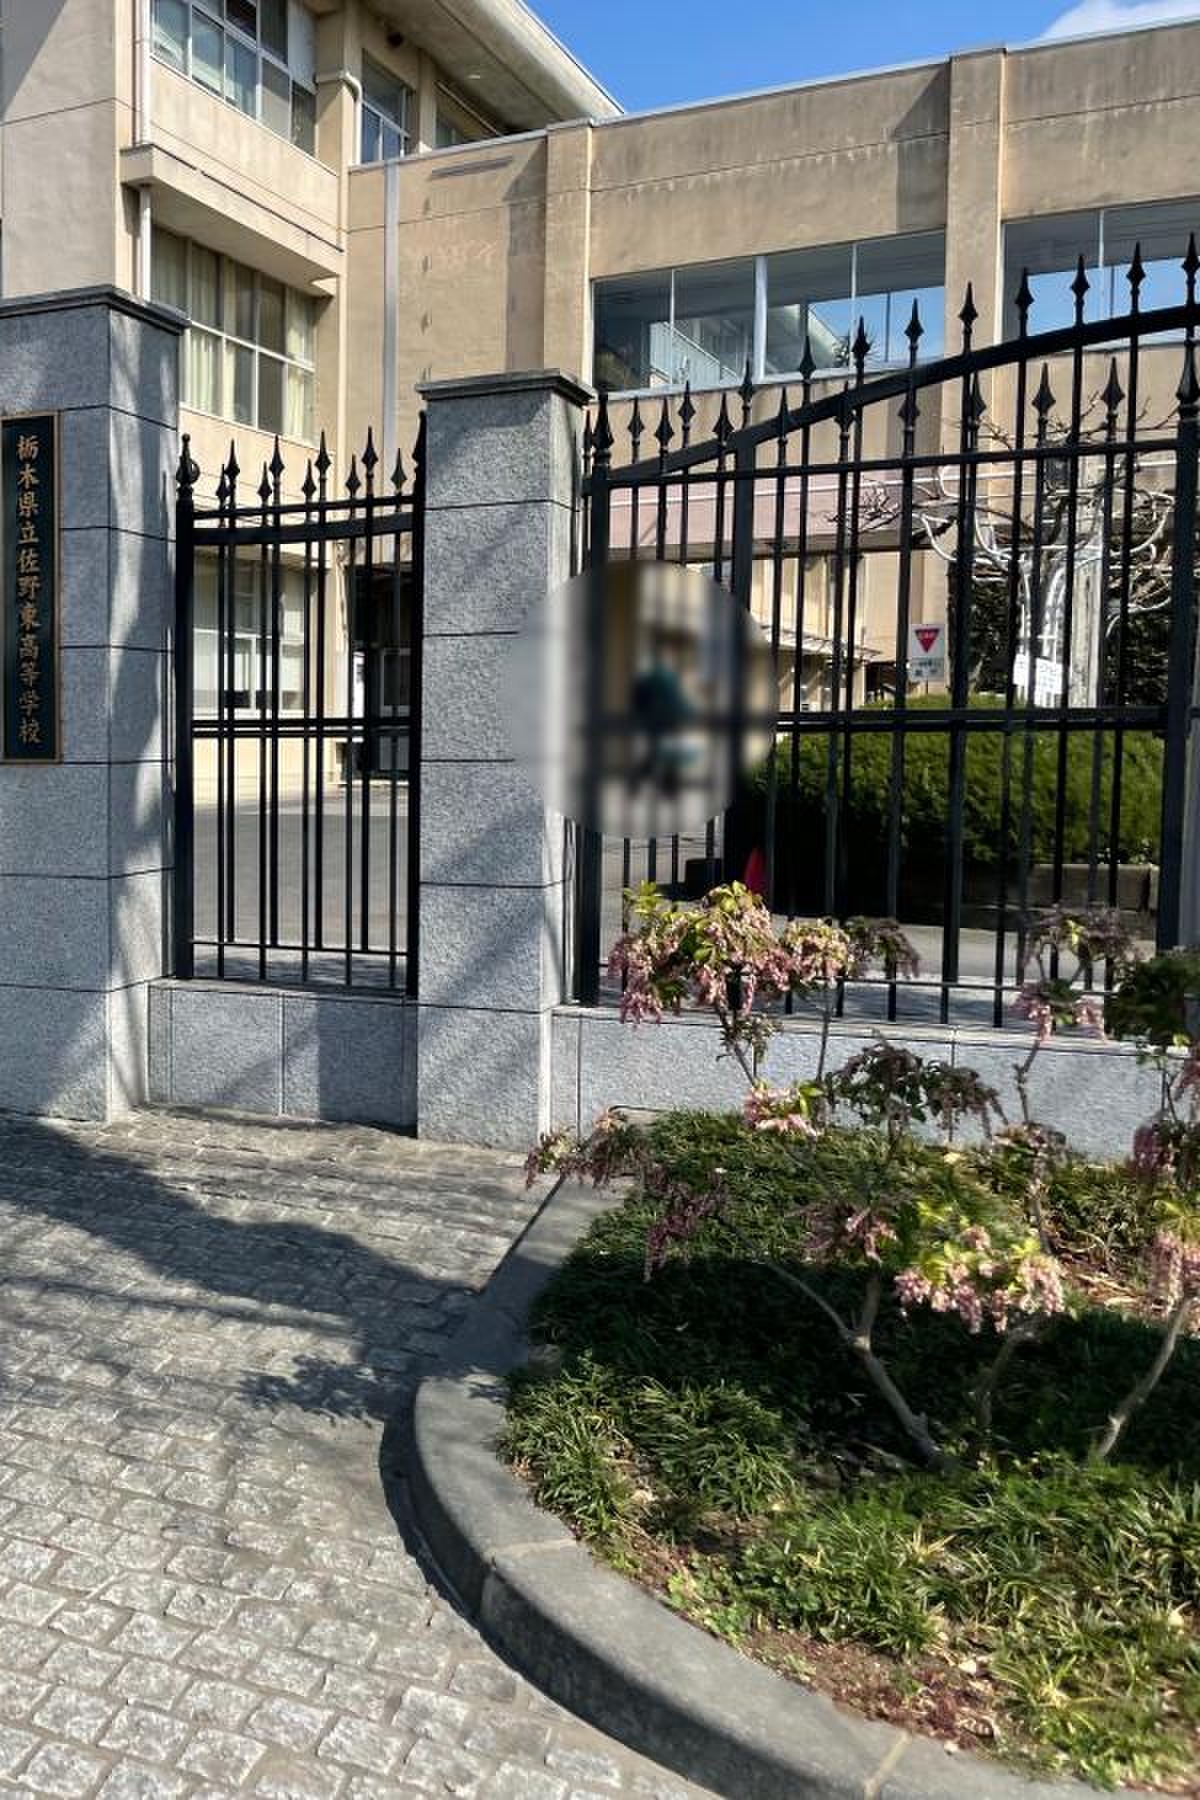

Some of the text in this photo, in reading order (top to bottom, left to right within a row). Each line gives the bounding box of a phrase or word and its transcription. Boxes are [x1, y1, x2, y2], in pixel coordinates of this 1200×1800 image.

[16, 434, 42, 744] 栃木県立佐野東高等学校
